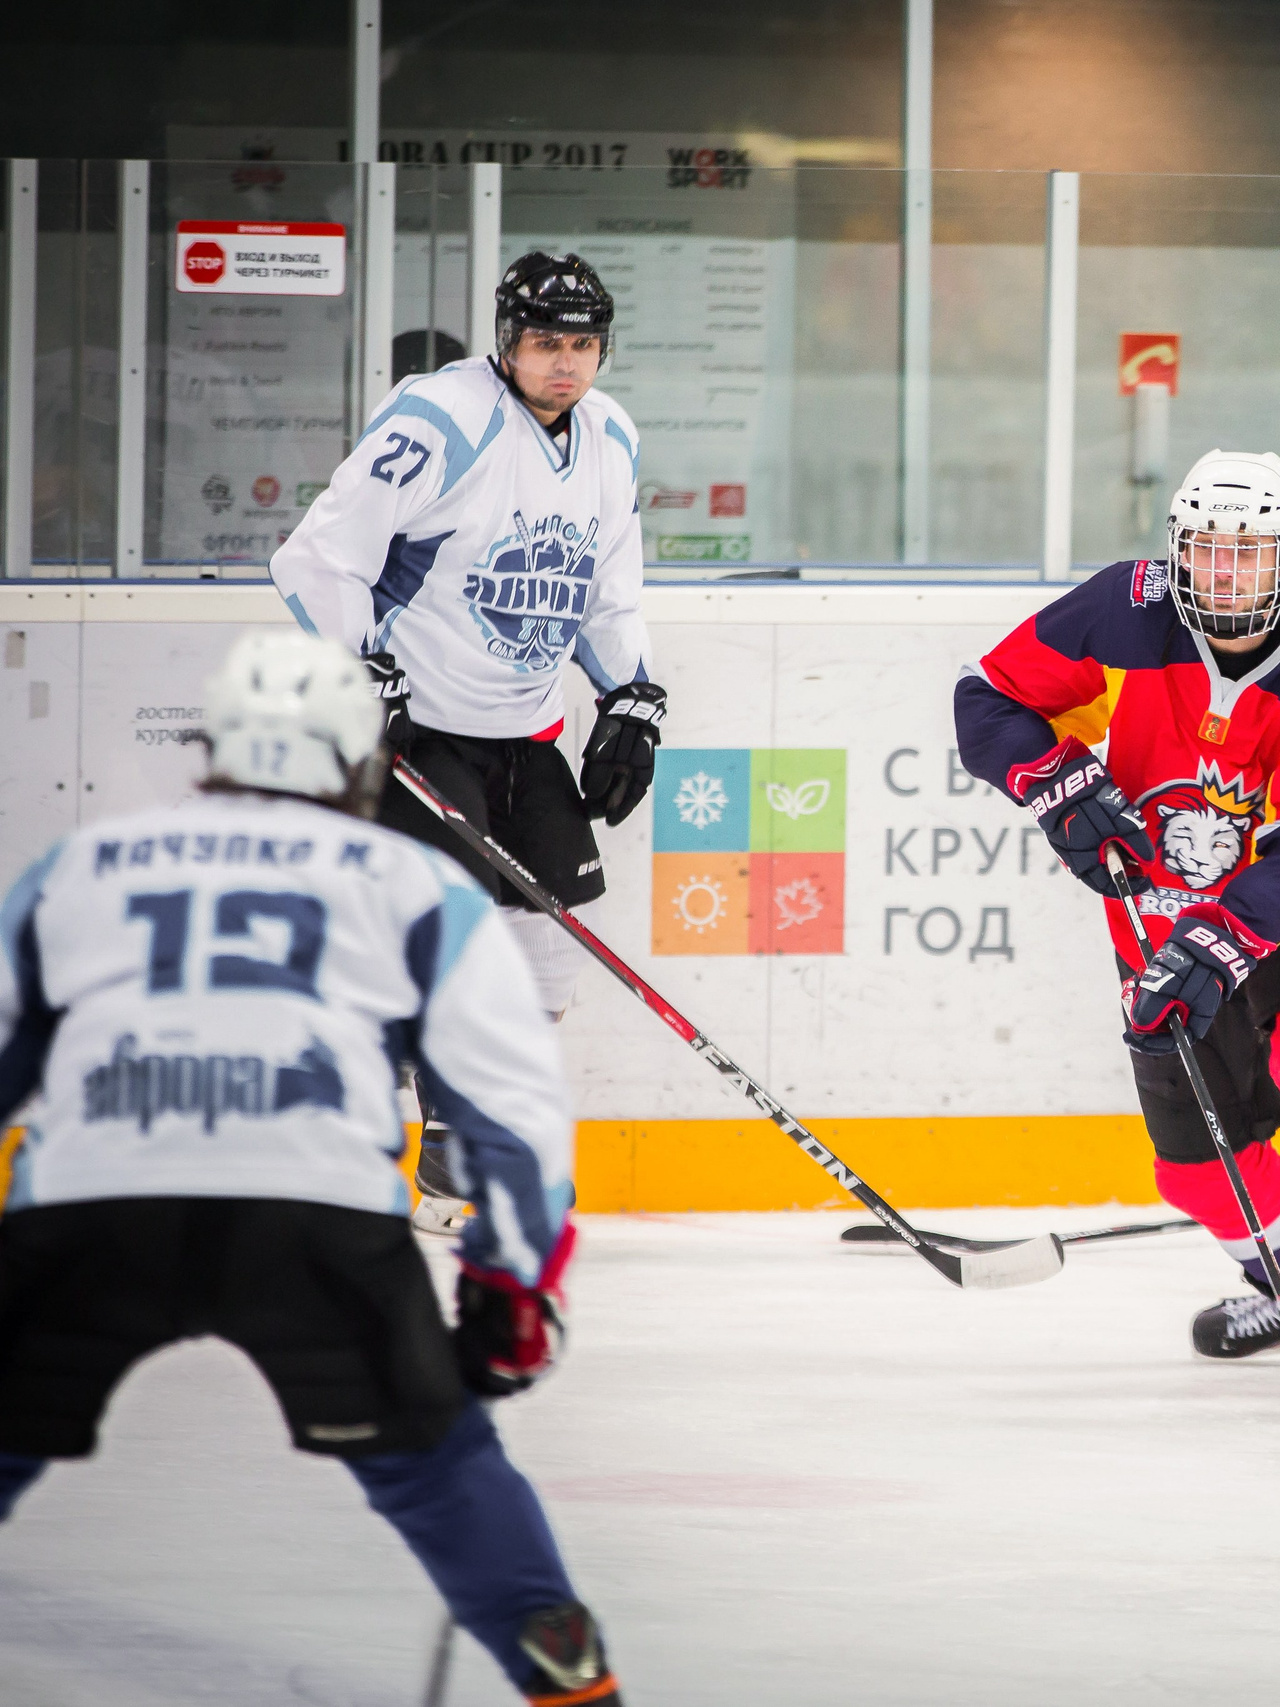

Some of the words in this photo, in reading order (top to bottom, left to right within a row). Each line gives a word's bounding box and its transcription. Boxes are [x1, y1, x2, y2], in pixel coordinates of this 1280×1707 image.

[337, 140, 449, 169] IORA
[543, 143, 630, 172] 2017
[187, 257, 223, 270] STOP
[235, 252, 266, 263] ВХОД
[269, 254, 276, 263] И
[279, 253, 321, 265] ВЫХОД
[235, 267, 270, 278] ЧЕРЕЗ
[272, 268, 330, 280] ТУРНИКЕТ
[370, 432, 431, 489] 27
[1212, 504, 1246, 512] CCM
[534, 514, 577, 541] НПО
[136, 729, 206, 745] курор
[884, 828, 1062, 877] КРУГ
[1157, 888, 1219, 904] PUSHK
[124, 888, 327, 1001] 12
[884, 906, 1015, 963] ГОД
[1184, 926, 1250, 989] BAU
[699, 1043, 862, 1191] EASTON
[873, 1205, 920, 1247] SYNERGY
